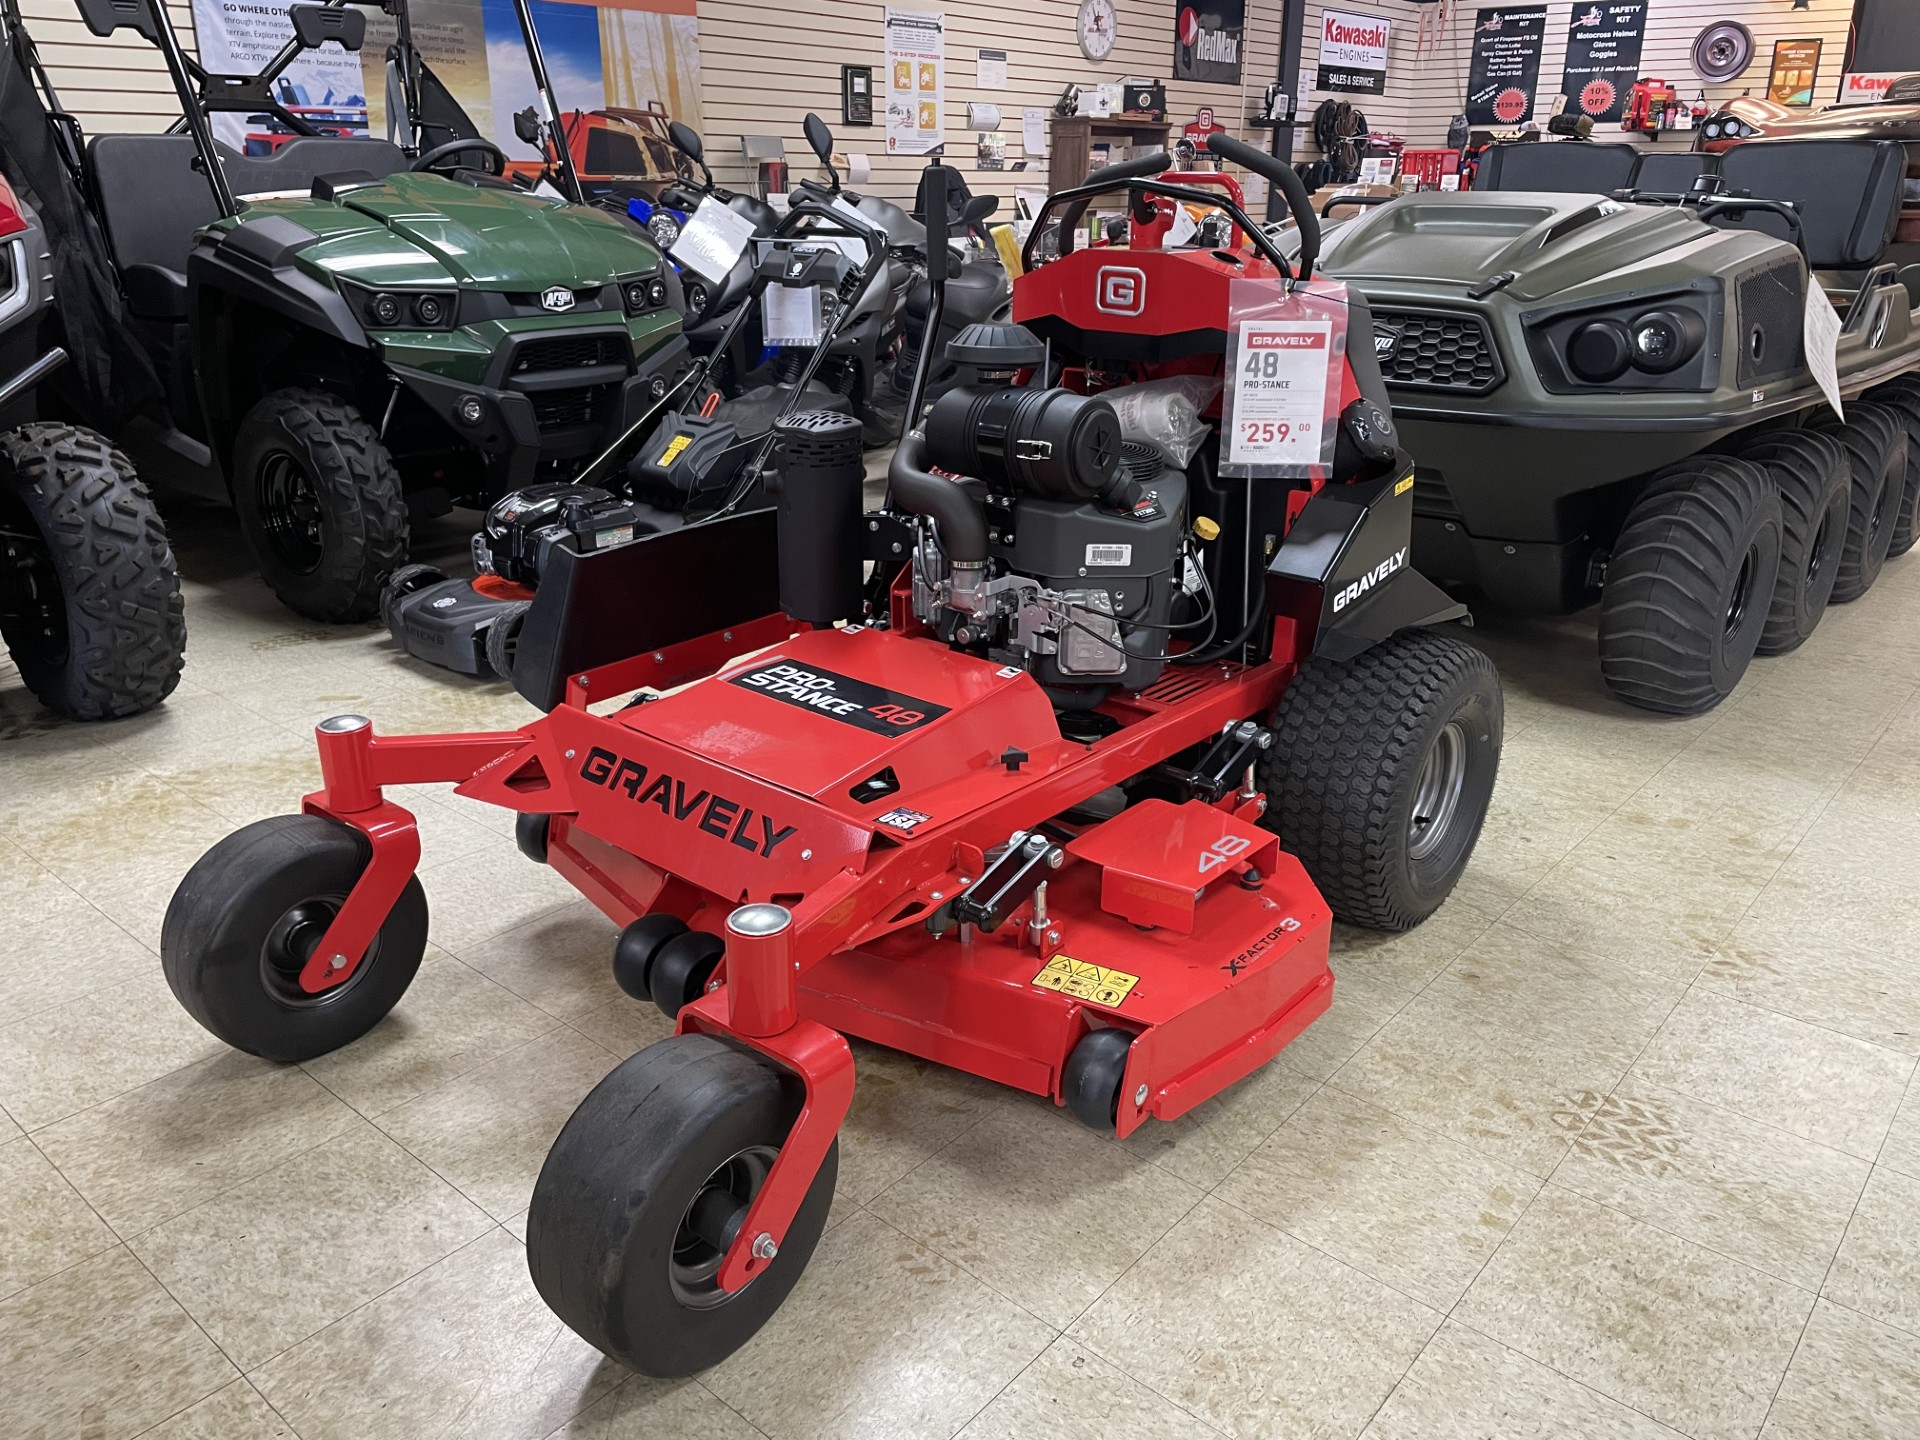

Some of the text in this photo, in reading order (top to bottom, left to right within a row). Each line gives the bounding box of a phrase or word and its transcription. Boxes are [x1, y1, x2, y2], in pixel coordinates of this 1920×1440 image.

[223, 3, 291, 17] GO WHERE OTH
[1504, 12, 1546, 20] MAINTENANCE
[1608, 5, 1642, 14] SAFETY
[224, 16, 293, 29] through the nasties
[1616, 15, 1631, 23] KIT
[226, 28, 292, 41] terrain. Explore the
[1325, 17, 1386, 48] Kawasaki
[1576, 31, 1611, 39] Motocross
[242, 41, 281, 52] amphibious
[1197, 27, 1237, 64] RedMax
[1339, 47, 1370, 63] ENGINES
[1589, 50, 1617, 59] Goggles
[316, 58, 342, 68] because
[1328, 72, 1347, 85] SALES
[1352, 75, 1375, 87] SERVICE
[1849, 75, 1895, 90] Kaw
[1590, 87, 1609, 95] 10%
[1870, 92, 1885, 101] EN
[1587, 98, 1606, 106] OFF
[1186, 132, 1211, 143] GRAV
[545, 291, 571, 306] Argo
[1252, 336, 1315, 345] GRAVELY
[1244, 351, 1279, 378] 48
[1243, 380, 1291, 389] PRO-STANCE
[1333, 546, 1407, 613] GRAVELY
[764, 664, 837, 691] PRO-
[741, 672, 925, 726] STANCE 48
[579, 745, 798, 859] GRAVELY
[878, 812, 918, 830] USA
[1198, 835, 1251, 874] 48
